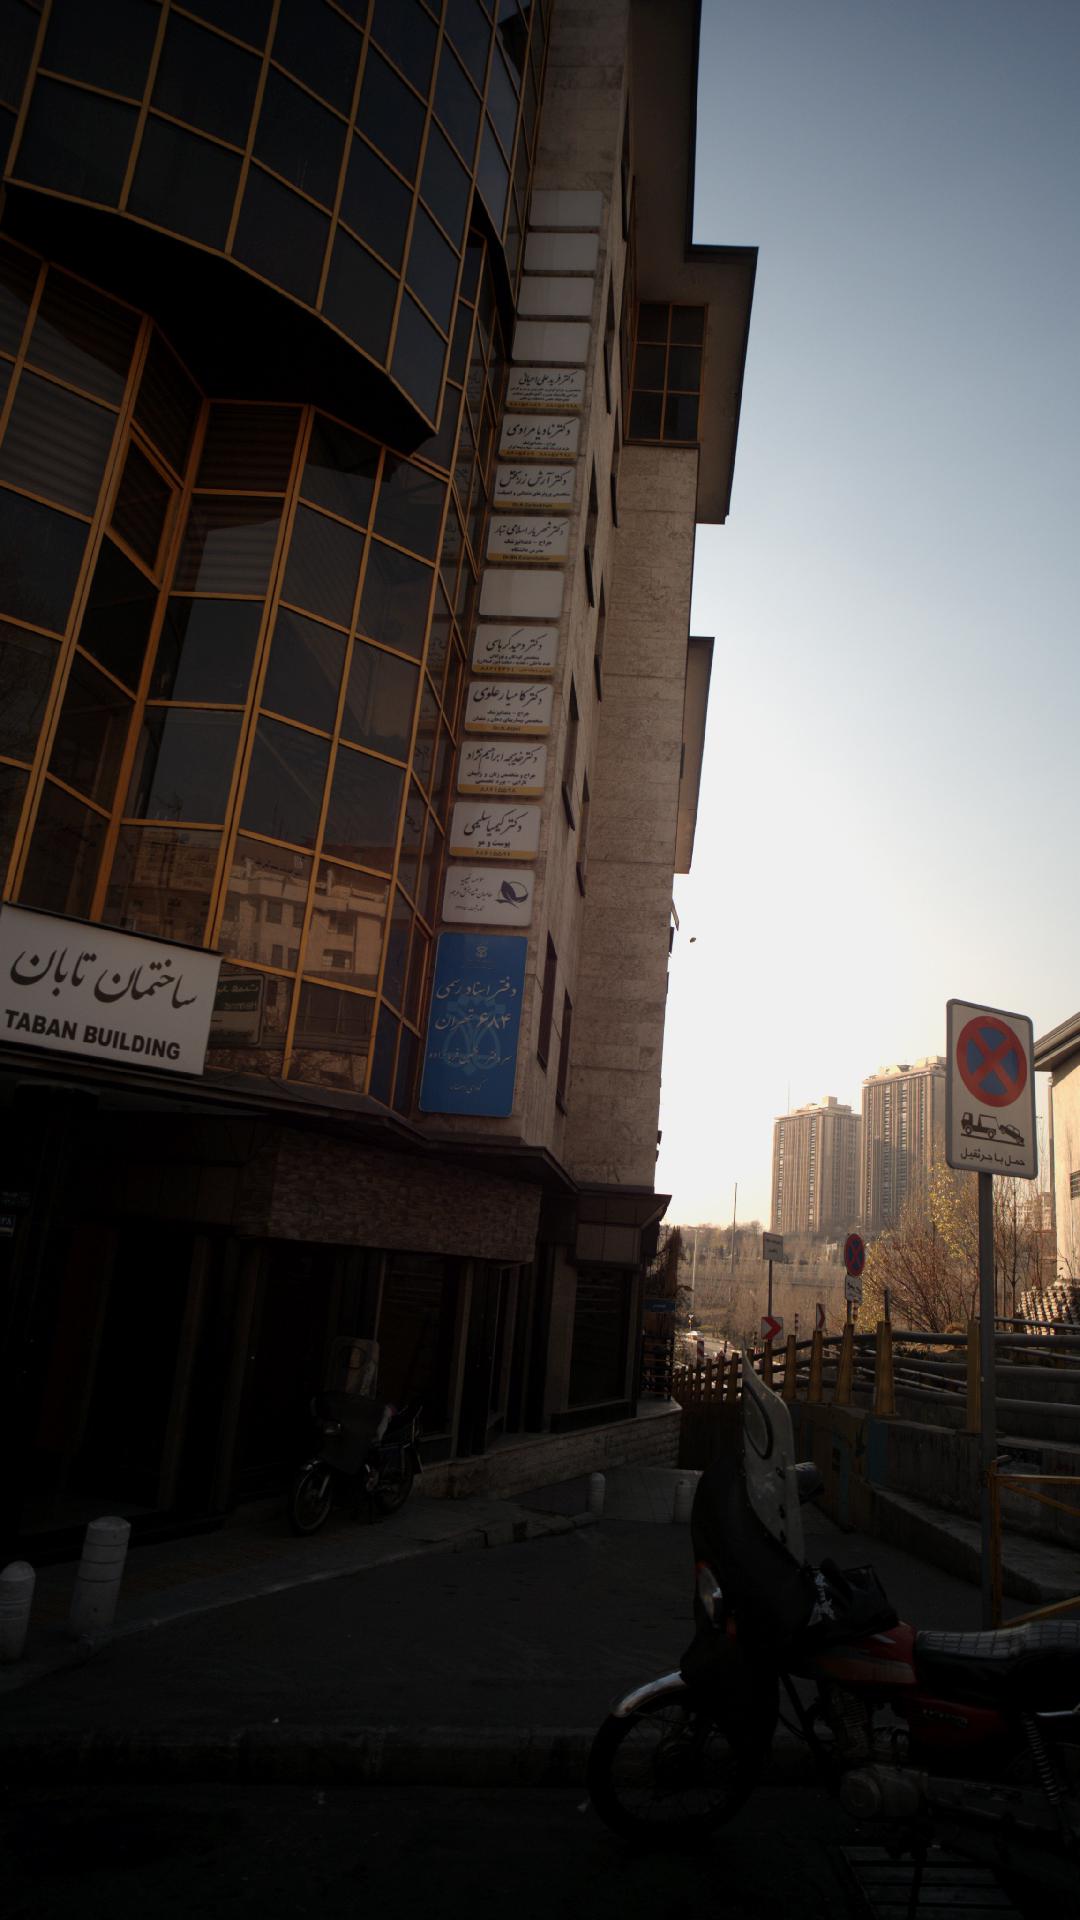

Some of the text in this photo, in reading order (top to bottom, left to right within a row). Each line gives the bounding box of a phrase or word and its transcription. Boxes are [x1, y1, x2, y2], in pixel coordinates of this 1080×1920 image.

[557, 370, 578, 386] دکتر
[548, 418, 577, 439] دکتر
[527, 470, 554, 487] آرش
[548, 469, 572, 489] دکتر
[546, 521, 569, 538] دکتر
[524, 633, 549, 653] دکتر
[473, 686, 549, 708] دکتر کامیار علوی
[519, 746, 543, 766] دکتر
[463, 808, 529, 837] دکتر کیمیا سلیمی
[10, 948, 198, 1009] ساختمان تابان
[436, 975, 517, 1001] دفتر اسناد رسمی
[434, 1008, 512, 1031] ۶۸۴ تهران
[5, 1009, 181, 1060] TABAN BUILDING
[960, 1147, 1025, 1166] حمل با جرثقیل
